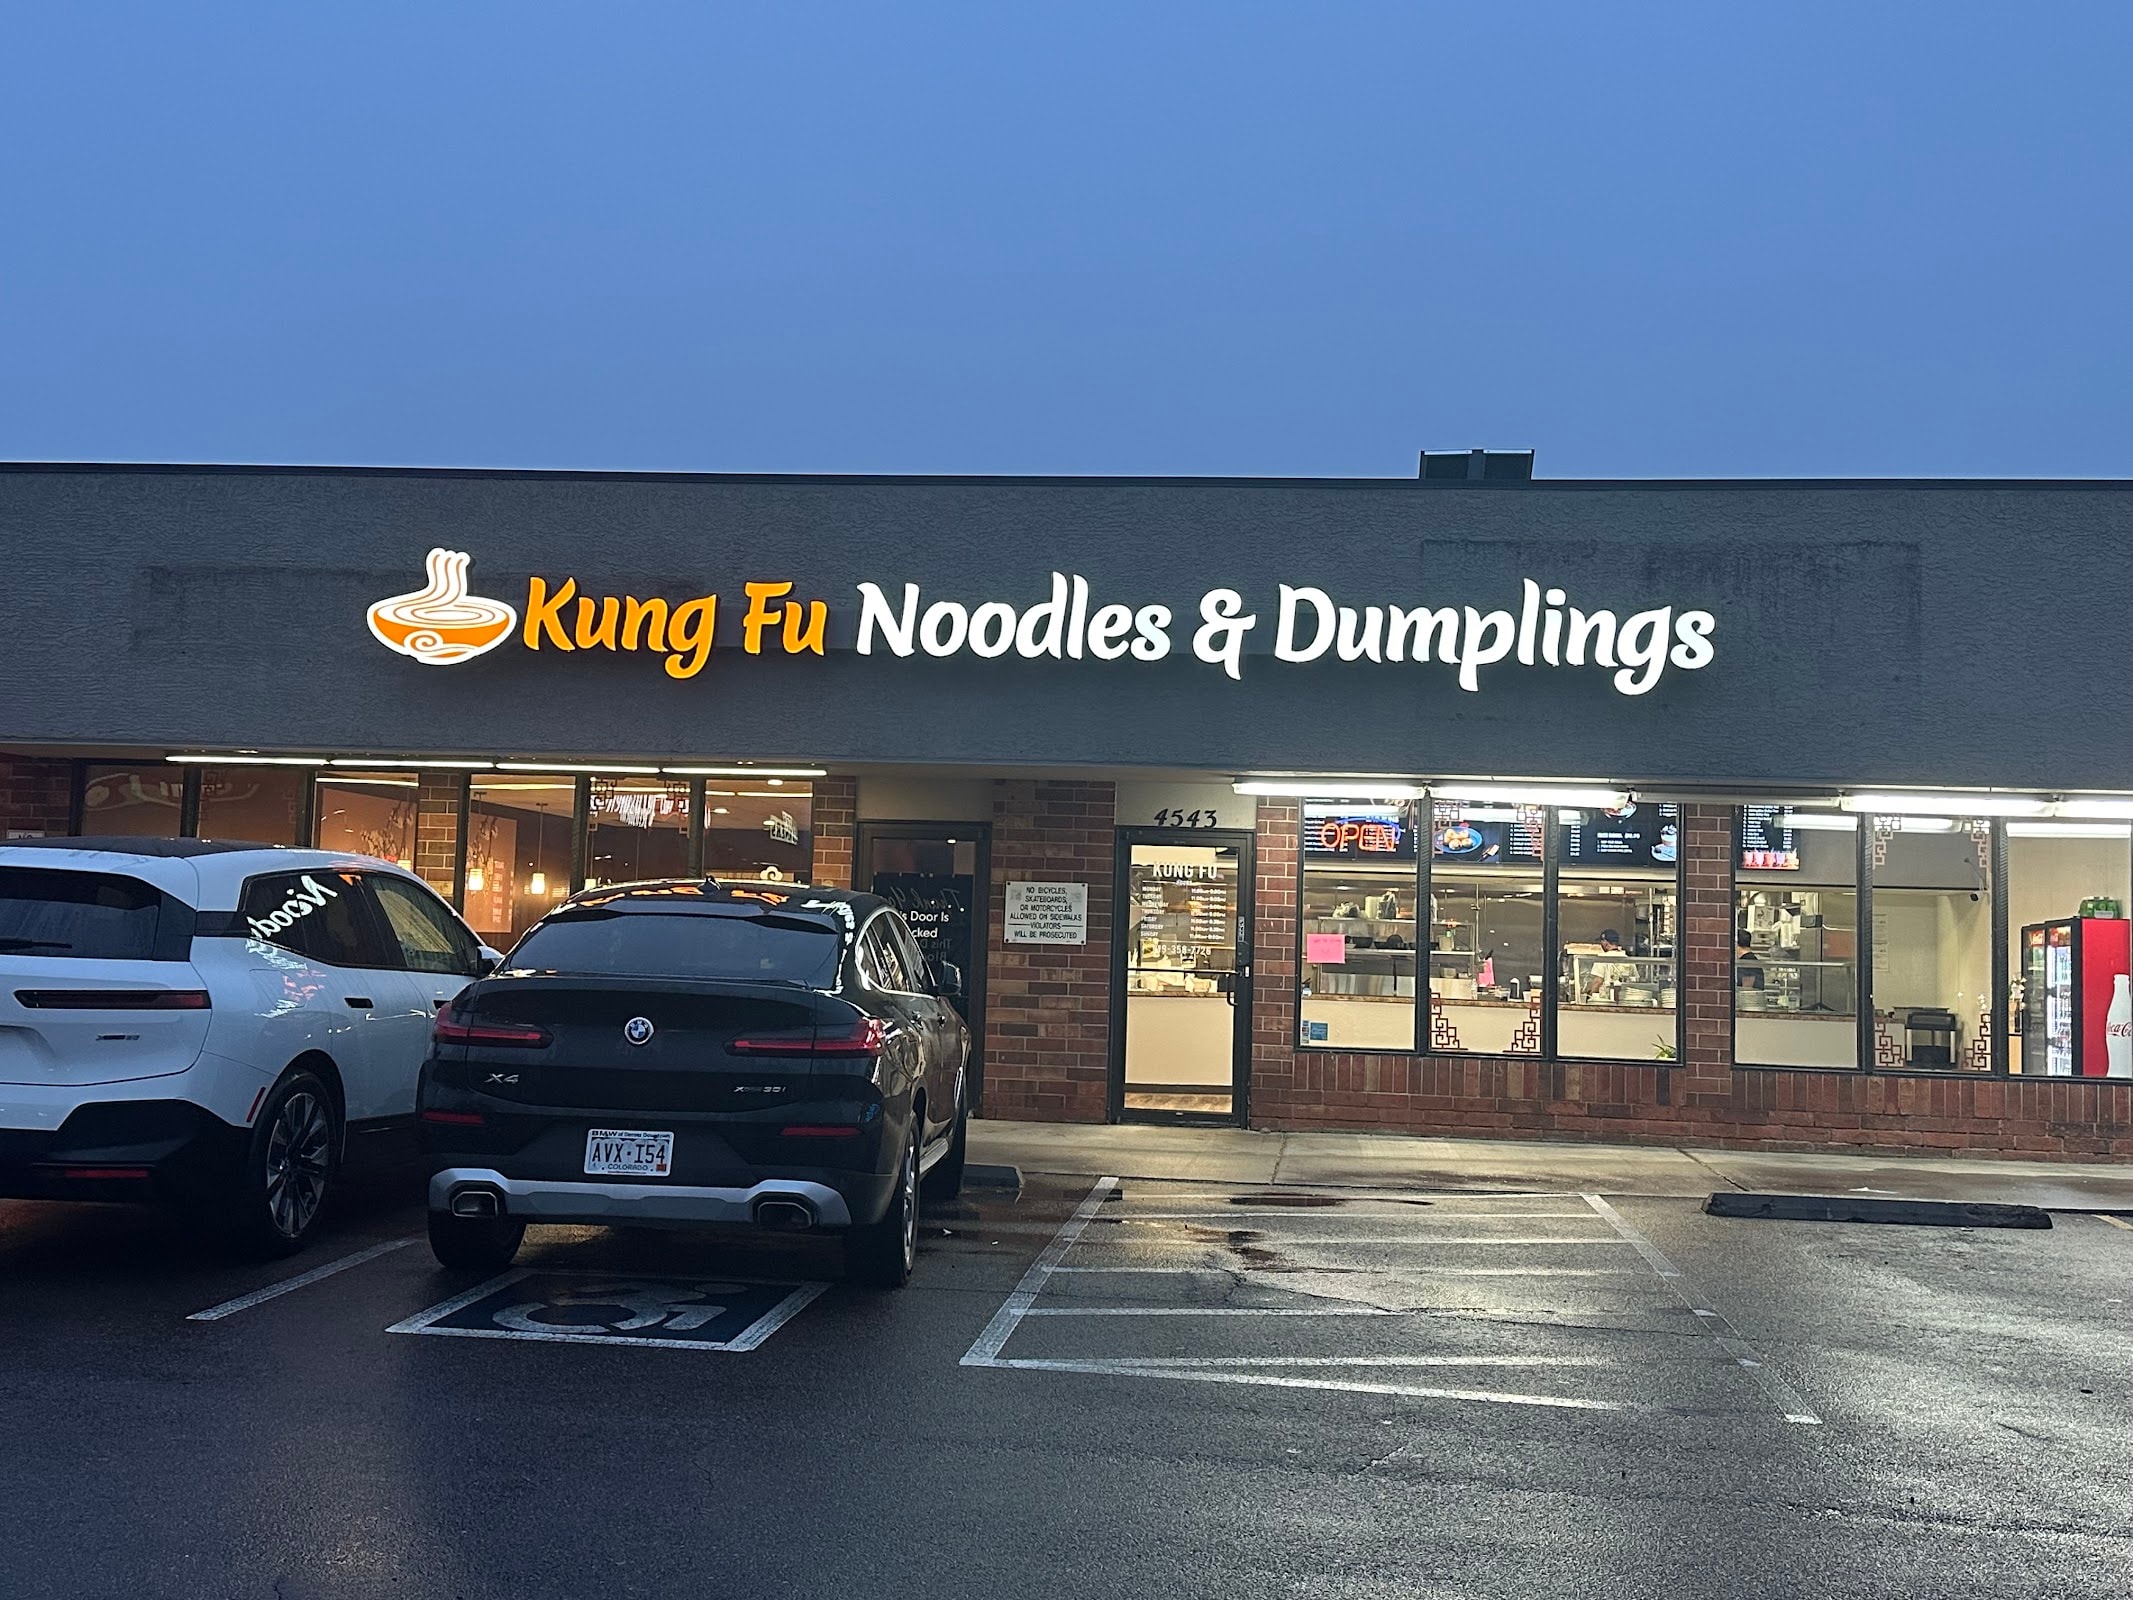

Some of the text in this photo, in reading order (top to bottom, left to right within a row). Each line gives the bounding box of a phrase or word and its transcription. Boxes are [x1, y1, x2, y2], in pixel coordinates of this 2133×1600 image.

[522, 571, 1716, 696] Kung Fu Noodles & Dumplings
[1153, 808, 1217, 829] 4543
[1320, 822, 1397, 852] OPEN
[1152, 863, 1218, 880] KUNG FU
[1026, 886, 1035, 894] NO
[1020, 904, 1073, 913] OR MOTORCYCLES
[910, 910, 938, 922] Door
[941, 911, 950, 923] Is
[1010, 912, 1083, 922] ALLOWED ON SIDEWALKS
[1030, 921, 1062, 930] VIOLATORS
[911, 926, 938, 938] cked
[1014, 930, 1027, 938] WILL
[1040, 931, 1078, 939] PROSECUTED
[484, 1073, 520, 1085] X4
[607, 1163, 649, 1171] COLORADO
